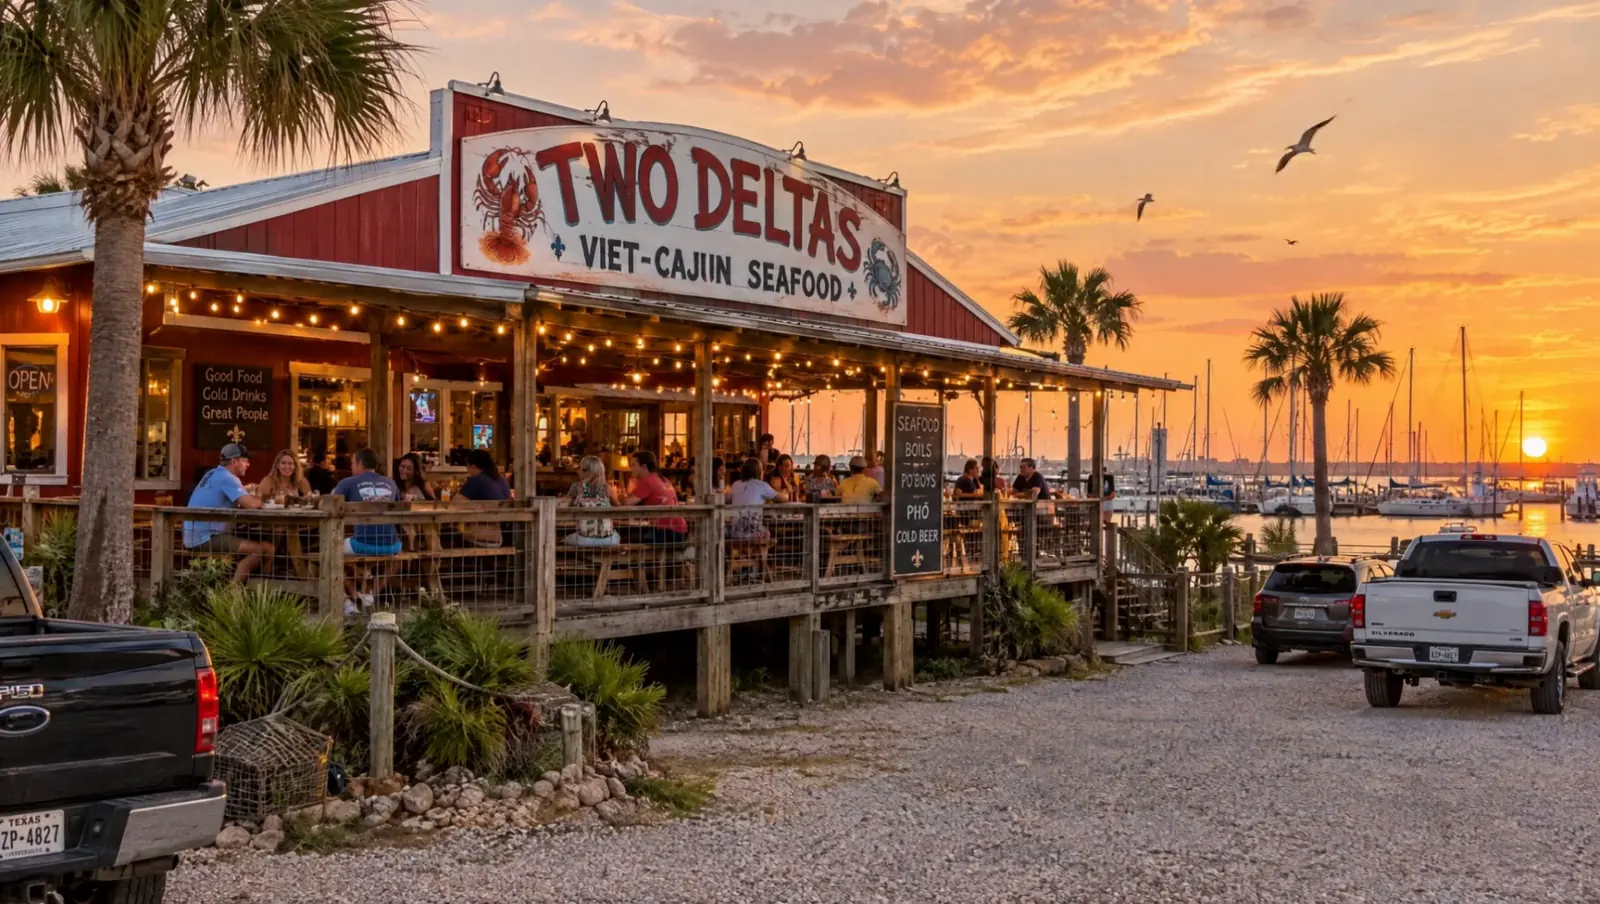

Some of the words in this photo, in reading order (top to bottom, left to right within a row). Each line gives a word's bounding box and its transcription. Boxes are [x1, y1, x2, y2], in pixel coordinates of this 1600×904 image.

[535, 141, 679, 227] TWO
[690, 146, 862, 273] DELTAS
[747, 259, 842, 303] SEAFOOD
[8, 370, 51, 390] OPEN
[205, 367, 233, 383] Good
[237, 369, 263, 384] Food
[232, 388, 267, 403] Drinks
[201, 405, 233, 420] Great
[236, 406, 269, 423] People
[898, 415, 940, 432] SEAFOOD
[905, 442, 932, 458] BOILS
[896, 530, 917, 543] COLD
[919, 529, 939, 543] BEER
[8, 815, 41, 828] TEXAS
